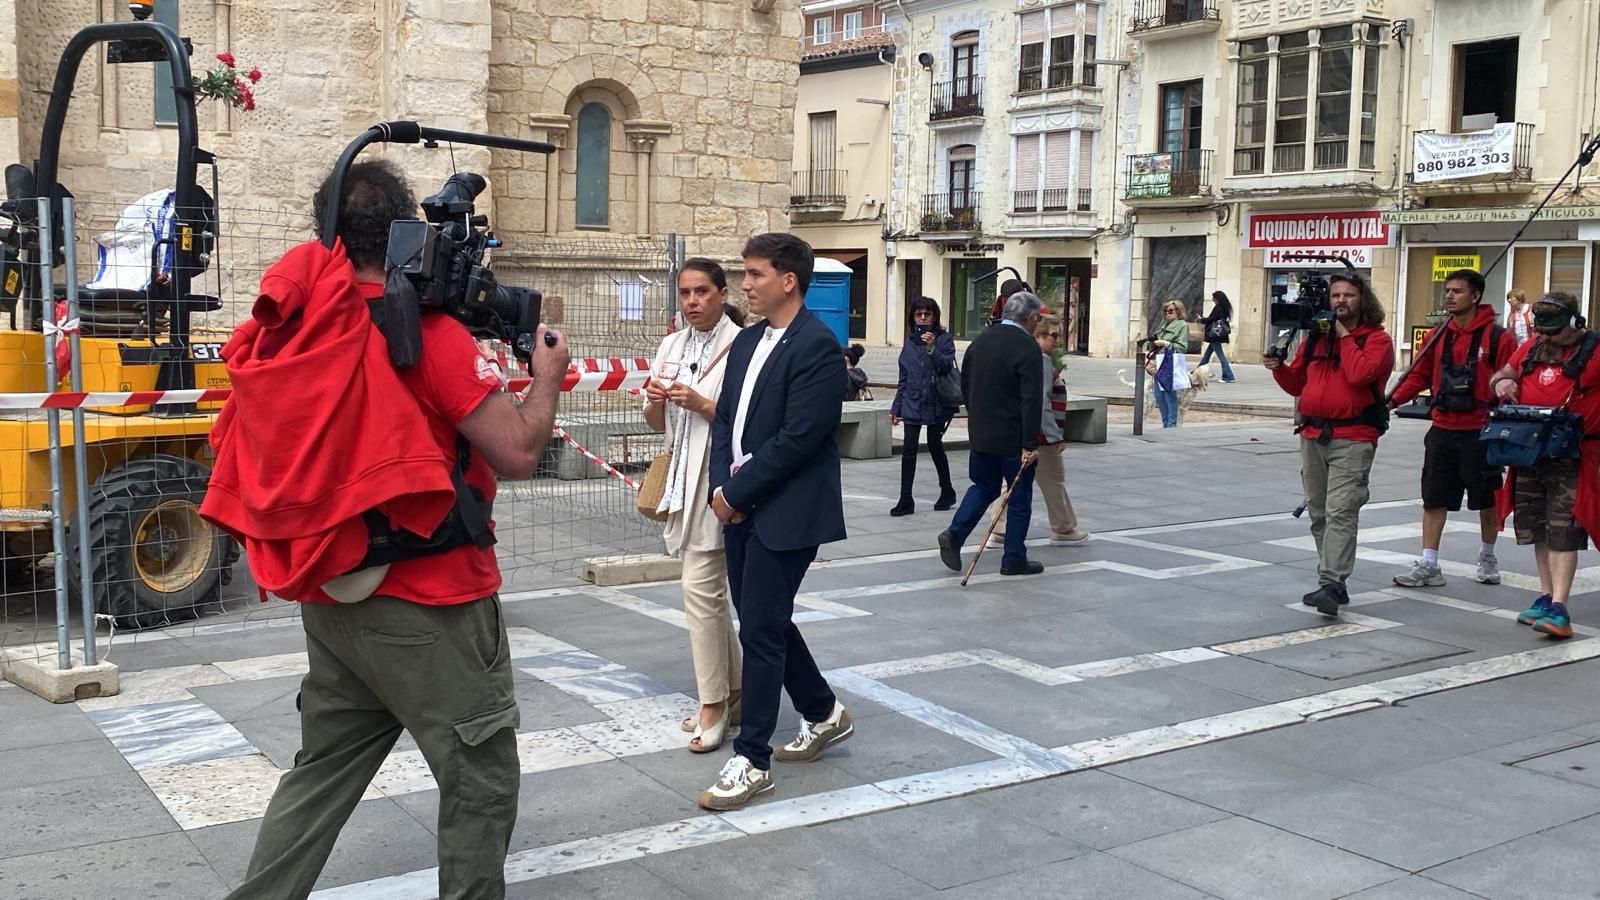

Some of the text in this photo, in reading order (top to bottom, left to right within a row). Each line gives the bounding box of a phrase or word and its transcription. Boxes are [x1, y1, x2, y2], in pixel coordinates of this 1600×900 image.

[1431, 146, 1494, 159] VENTA DE PISOS
[1417, 160, 1443, 173] 980
[1447, 156, 1477, 169] 982
[1481, 152, 1510, 165] 303
[1382, 213, 1430, 222] MATERIAL
[1254, 216, 1384, 242] LIQUIDACIÓN TOTAL
[1439, 257, 1475, 268] LIQUIDACIÓN
[1434, 271, 1445, 280] POR
